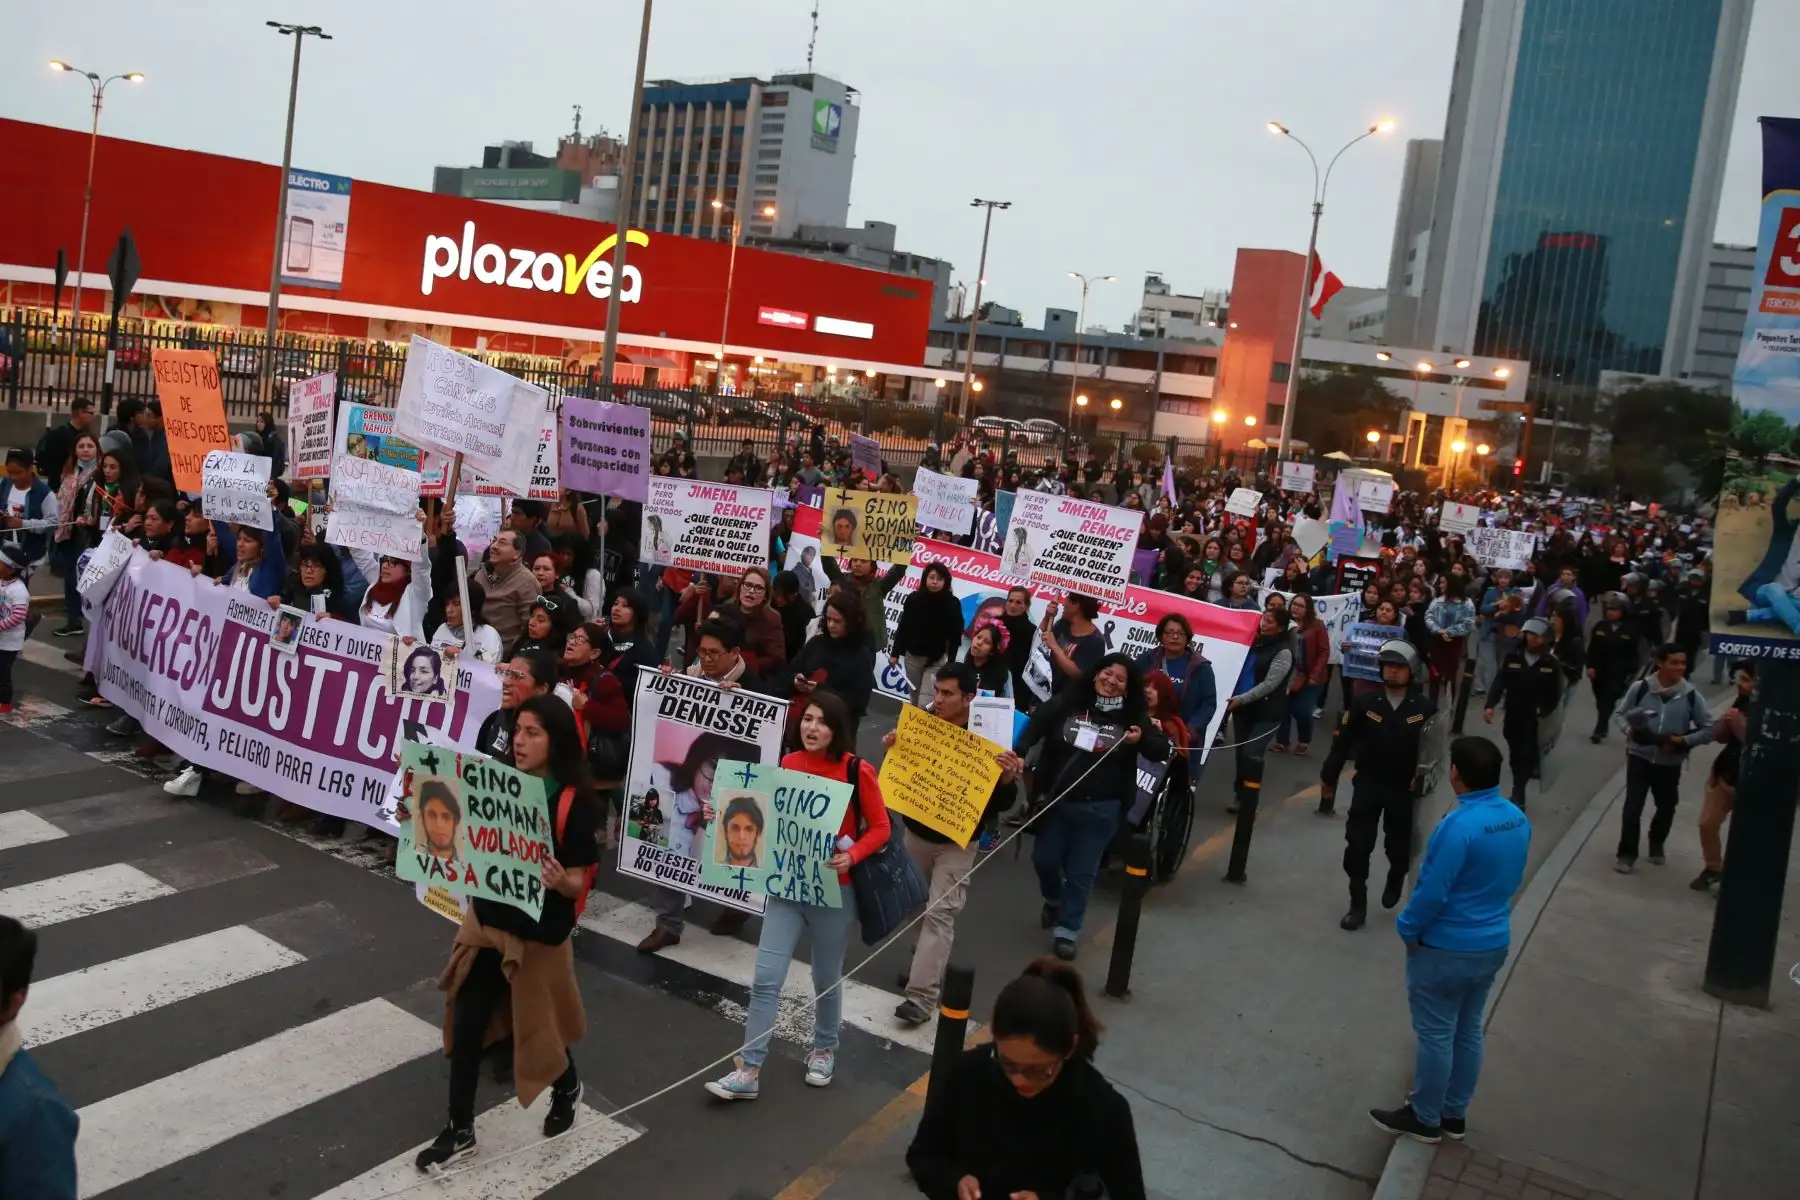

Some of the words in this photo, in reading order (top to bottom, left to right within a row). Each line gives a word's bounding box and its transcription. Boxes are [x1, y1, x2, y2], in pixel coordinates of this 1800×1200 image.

[288, 174, 330, 191] ELECTRO
[155, 360, 218, 390] REGISTRO
[180, 396, 192, 412] DE
[363, 410, 394, 422] BRENDA
[569, 415, 646, 438] Sobrevivientes
[166, 418, 227, 444] AGRESORES
[362, 424, 393, 435] NAHUIS
[570, 437, 617, 456] Personas
[621, 448, 641, 460] con
[243, 459, 255, 477] LA
[337, 455, 369, 484] ROSA
[570, 452, 640, 475] discapacidad
[206, 494, 216, 505] DE
[237, 500, 260, 513] CASO
[652, 482, 663, 490] ME
[663, 483, 678, 491] VOY
[687, 485, 738, 503] JIMENA
[652, 498, 675, 507] LUCHA
[654, 490, 674, 499] PERO
[1035, 496, 1050, 505] VOY
[643, 505, 659, 514] POR
[660, 508, 683, 517] TODOS
[712, 502, 767, 520] RENACE
[865, 497, 908, 516] GINO
[1022, 511, 1043, 521] LUCHA
[1024, 503, 1043, 512] PERO
[1057, 500, 1109, 522] JIMENA
[684, 514, 710, 524] ¿QUE
[711, 516, 758, 531] QUIEREN?
[689, 526, 714, 536] ¿QUE
[716, 528, 727, 537] LE
[727, 530, 752, 541] BAJE
[1011, 517, 1026, 526] POR
[1027, 520, 1051, 531] TODOS
[1080, 520, 1136, 542] RENACE
[336, 528, 357, 542] NO
[680, 534, 691, 543] LA
[692, 536, 716, 547] PENA
[717, 539, 725, 548] O
[726, 540, 746, 552] QUE
[747, 544, 759, 553] LO
[1050, 529, 1077, 541] ¿QUE
[1077, 535, 1124, 551] QUIEREN?
[673, 544, 713, 558] DECLARE
[713, 549, 766, 566] INOCENTE?
[1041, 549, 1053, 558] LA
[1053, 552, 1078, 565] PENA
[1078, 557, 1087, 567] O
[1087, 560, 1108, 572] QUE
[1107, 563, 1121, 575] LO
[1052, 541, 1079, 553] ¿QUE
[1080, 546, 1091, 556] LE
[1090, 550, 1116, 562] BAJE
[673, 557, 721, 571] ¡CORRUPCIÓN
[1033, 558, 1074, 576] DECLARE
[1074, 567, 1125, 587] INOCENTE?
[1030, 571, 1078, 590] ¡CORRUPCIÓN
[1078, 582, 1103, 597] NUNCA
[227, 599, 269, 629] ASAMBLEA
[334, 635, 343, 652] Y
[456, 668, 473, 689] MA
[1127, 627, 1160, 648] SÚMA
[1718, 642, 1761, 656] SORTEO
[1762, 646, 1772, 657] 7
[1772, 647, 1788, 659] DE
[646, 675, 721, 706] JUSTICIA
[731, 695, 779, 721] PARA
[102, 658, 129, 692] JUSTICIA
[157, 697, 167, 721] Y
[164, 703, 210, 752] CORRUPTA,
[219, 728, 270, 769] PELIGRO
[275, 751, 313, 785] PARA
[318, 766, 355, 797] LAS
[658, 695, 763, 740] DENISSE
[907, 712, 946, 737] VIOLARON
[903, 720, 936, 743] SUJETOS
[774, 787, 832, 820] GINO
[467, 794, 539, 836] ROMAN
[467, 825, 551, 865] VIOLADOR
[777, 817, 838, 861] ROMAN
[637, 845, 664, 861] QUE
[664, 851, 697, 872] ESTE
[773, 848, 807, 881] VAS
[812, 861, 823, 885] A
[416, 853, 459, 882] VAS
[464, 863, 479, 889] A
[485, 865, 542, 910] CAER
[633, 857, 653, 873] NO
[655, 864, 697, 887] QUEDE
[766, 873, 829, 907] CAER
